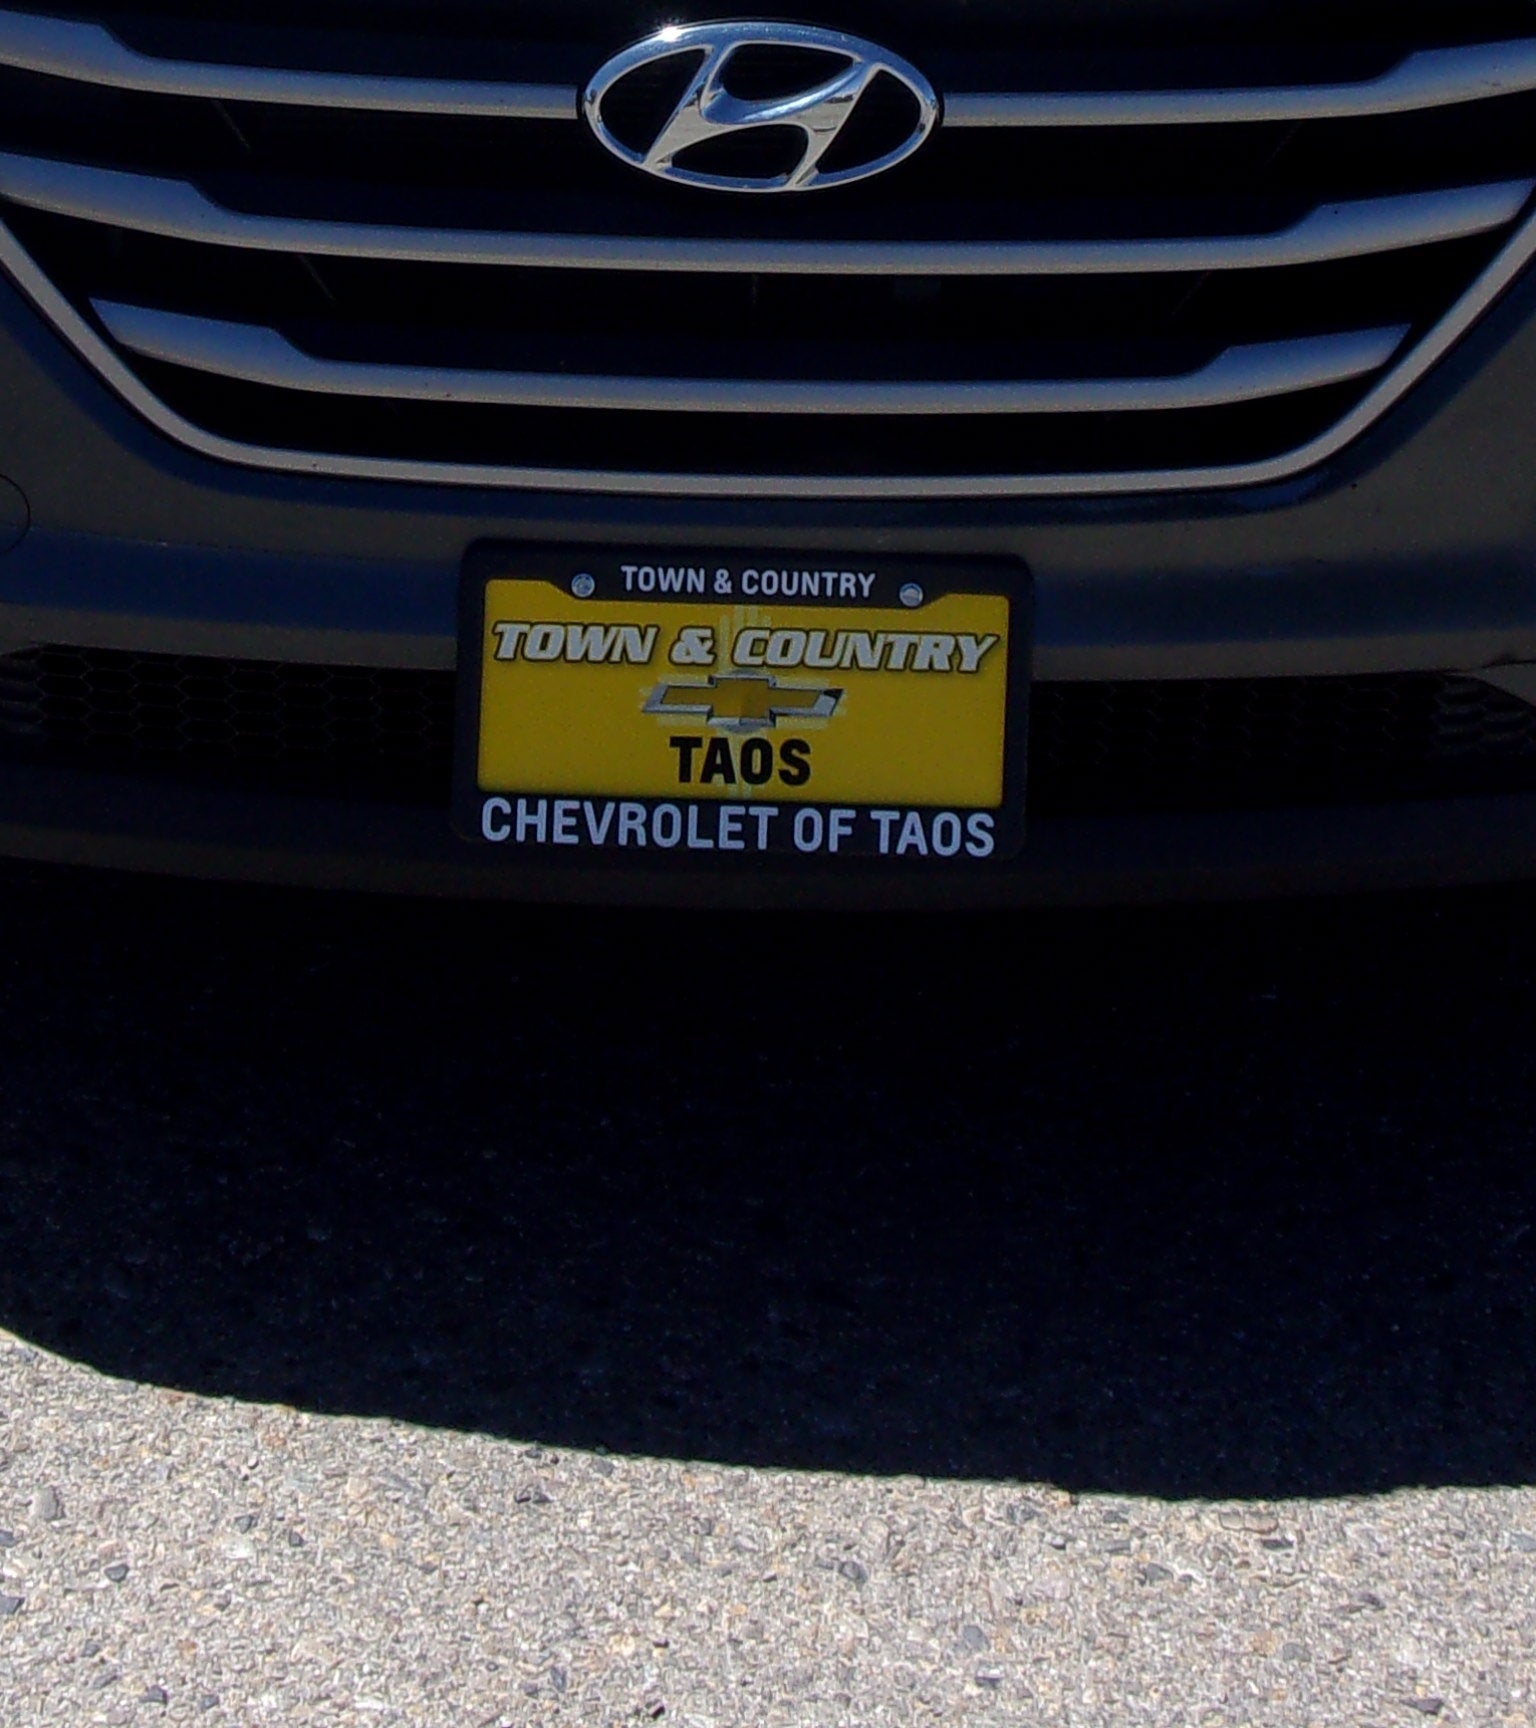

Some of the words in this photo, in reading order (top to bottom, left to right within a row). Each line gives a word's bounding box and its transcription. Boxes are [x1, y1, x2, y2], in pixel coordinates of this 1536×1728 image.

[620, 565, 706, 595] TOWN
[713, 568, 733, 596] &
[740, 568, 876, 599] COUNTRY
[492, 621, 659, 664] TOWN
[670, 625, 715, 665] &
[731, 627, 1000, 673] COUNTRY
[669, 736, 812, 787] TAOS
[481, 797, 779, 851] CHEVROLET
[793, 807, 857, 853] OF
[870, 810, 996, 858] TAOS
